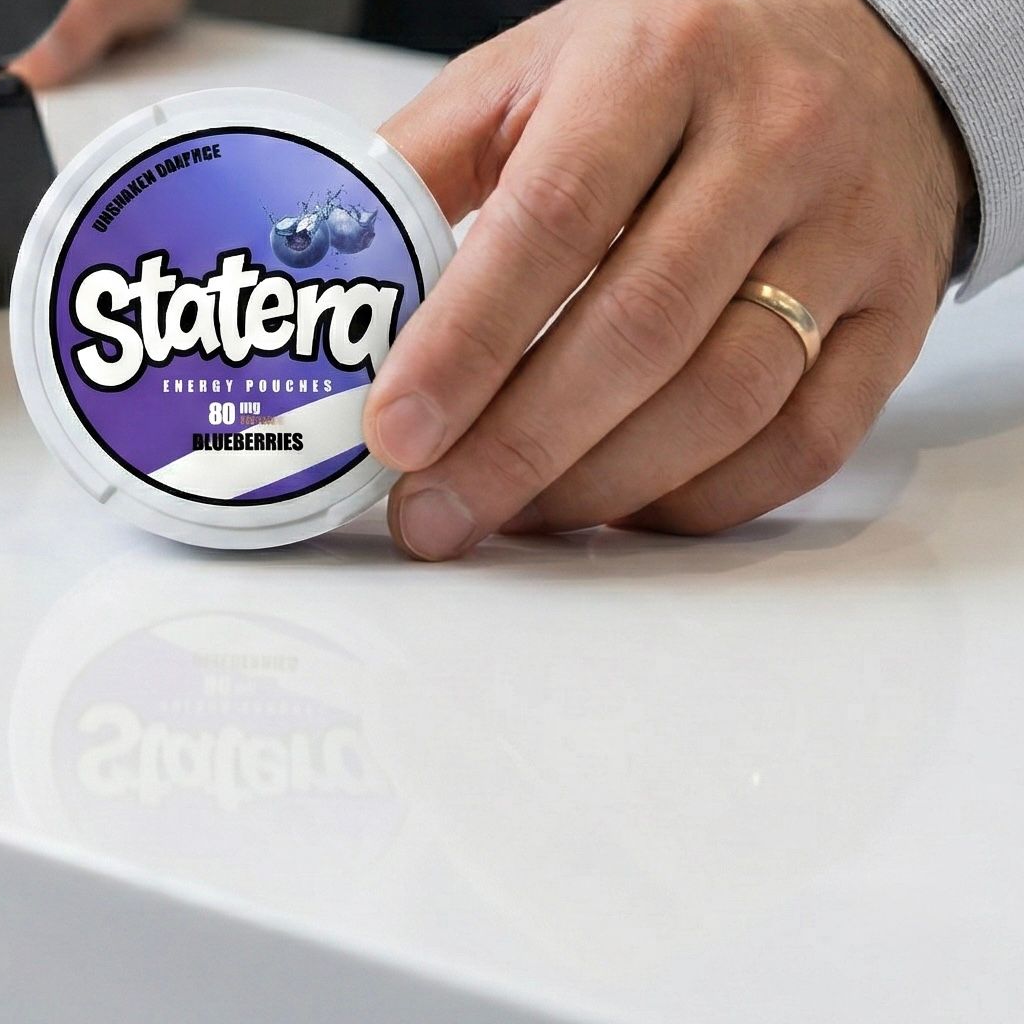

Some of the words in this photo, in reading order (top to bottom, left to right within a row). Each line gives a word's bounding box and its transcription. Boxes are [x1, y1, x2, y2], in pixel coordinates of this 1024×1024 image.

[72, 250, 401, 389] Statera
[163, 379, 233, 393] ENERGY
[245, 379, 333, 393] POUCHES
[208, 401, 236, 425] 80
[239, 402, 261, 414] mg
[192, 432, 304, 451] BLUEBERRIES
